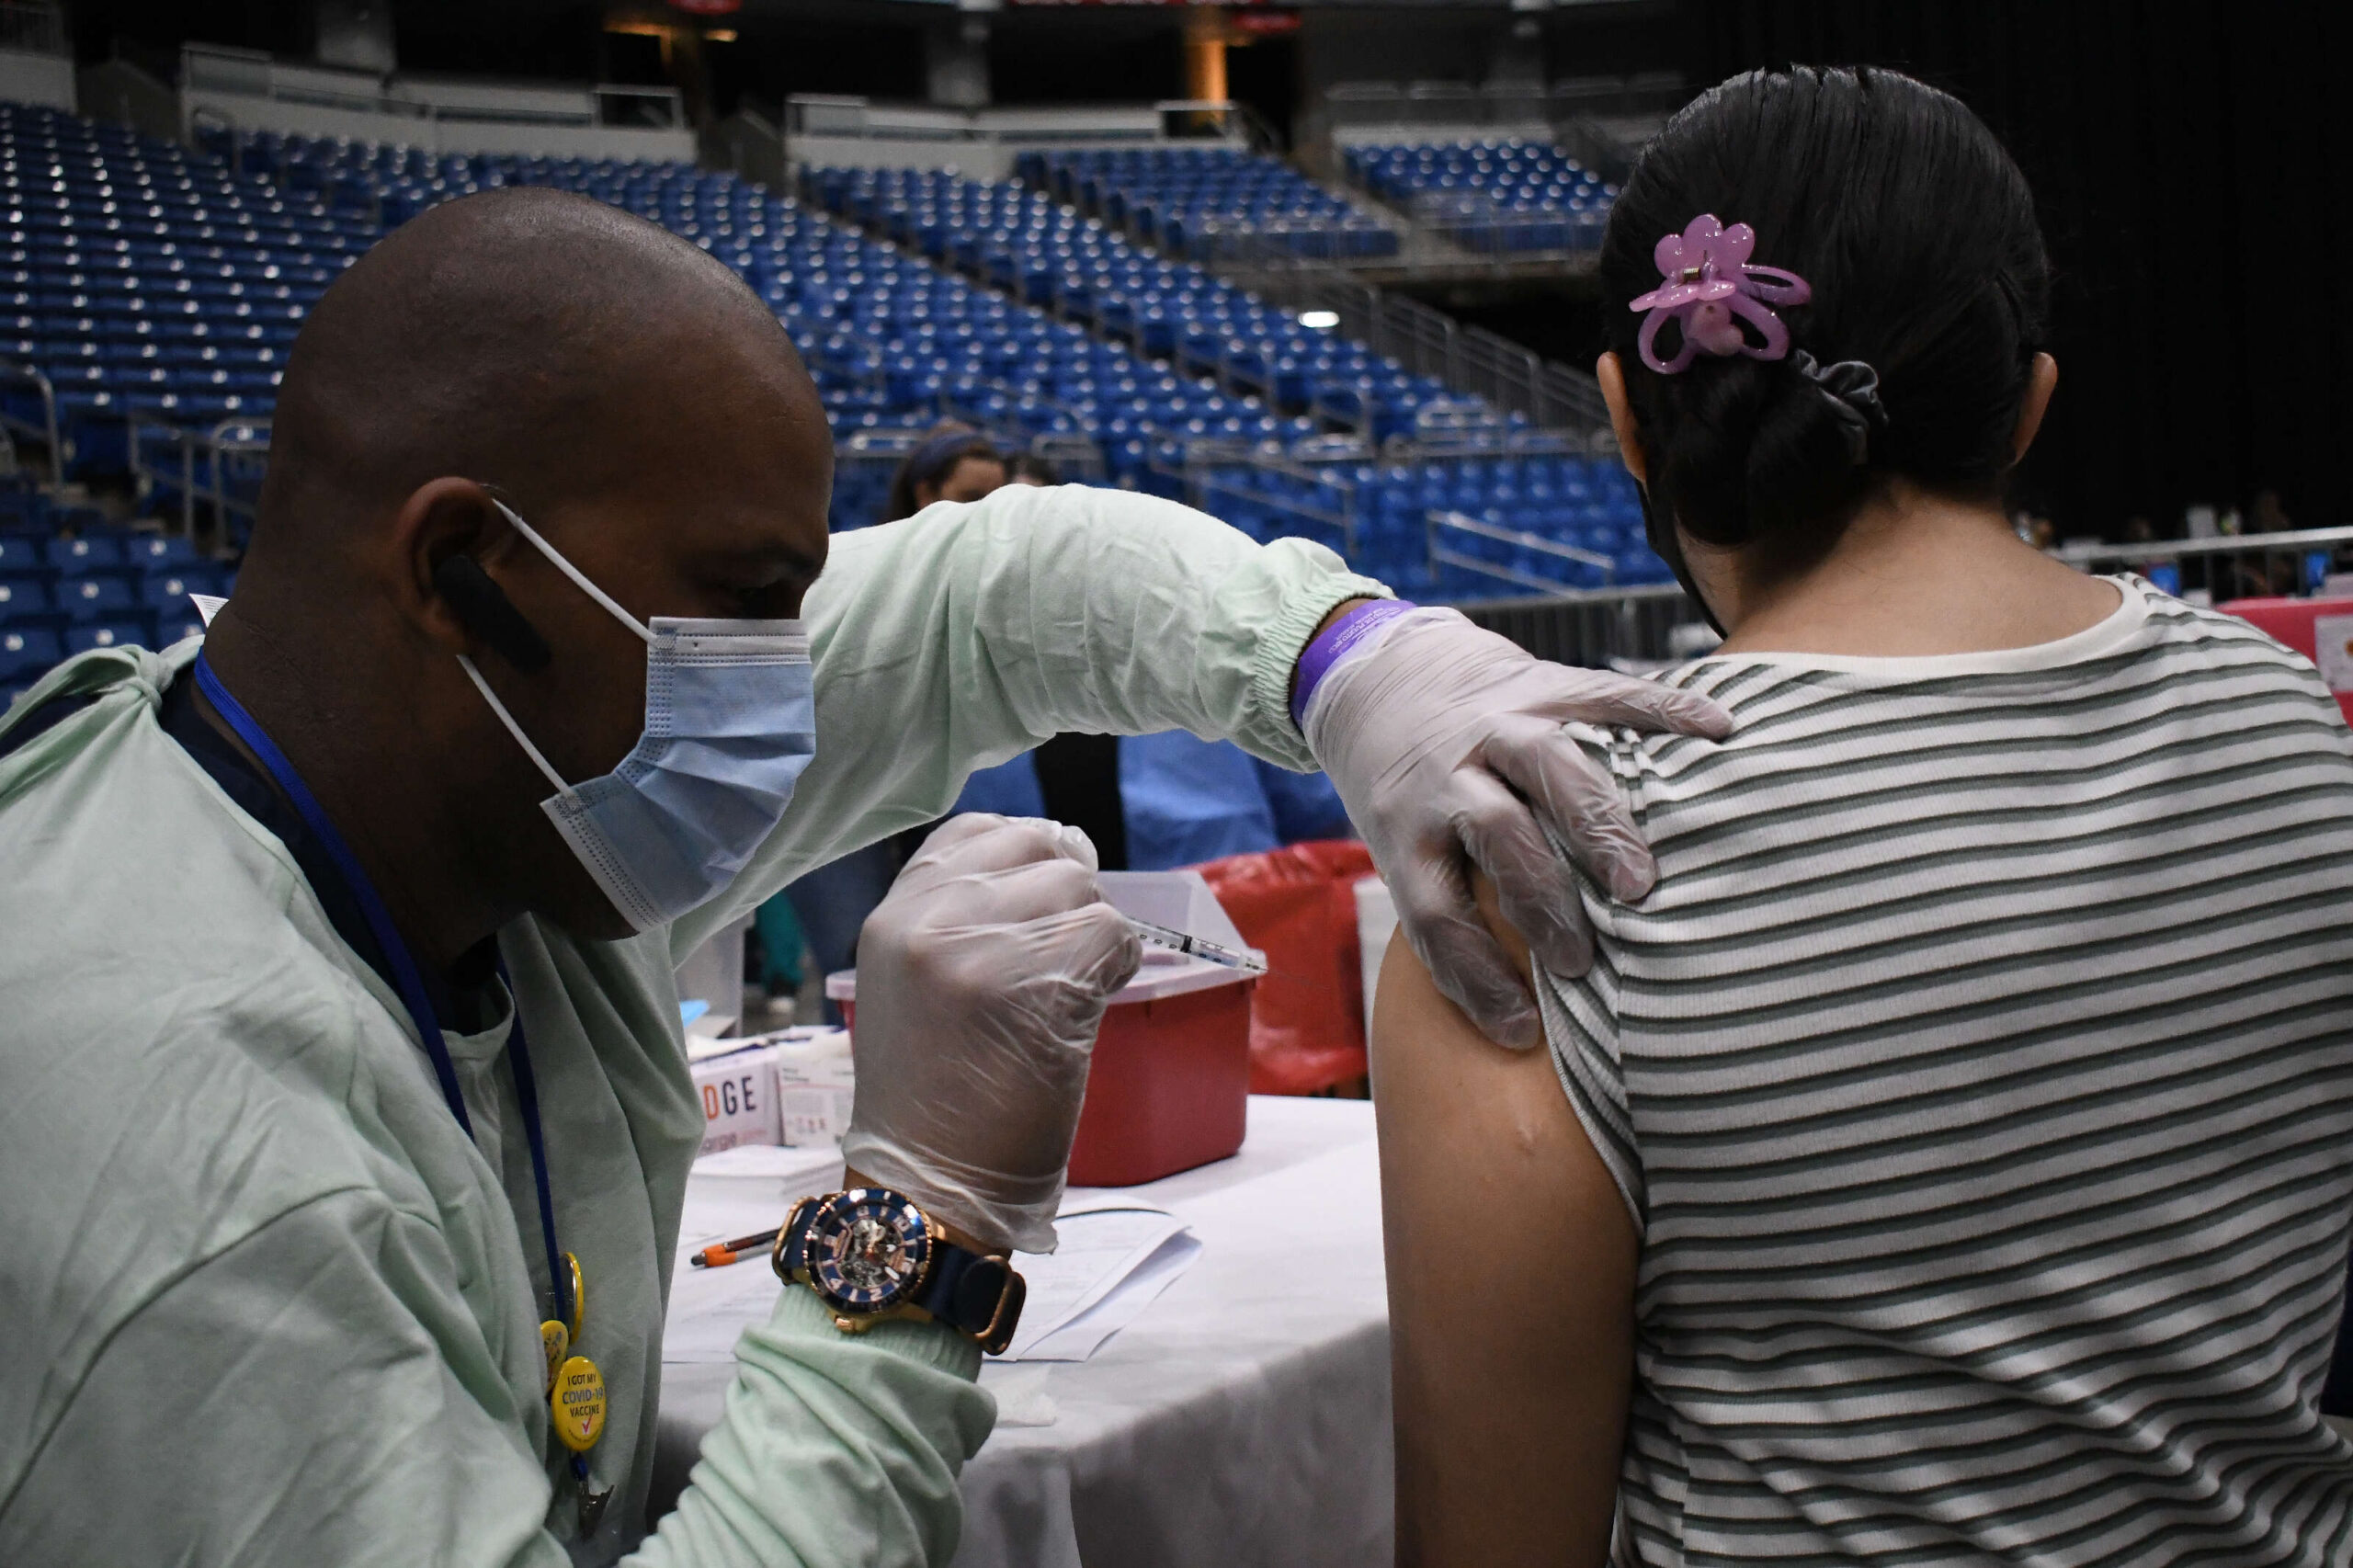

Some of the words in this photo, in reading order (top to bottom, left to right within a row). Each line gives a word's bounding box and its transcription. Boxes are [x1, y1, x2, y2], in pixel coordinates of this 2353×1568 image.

[567, 1376, 570, 1386] I
[572, 1373, 585, 1385] GOT
[587, 1372, 596, 1384] MY
[563, 1387, 603, 1404] COVID-19
[570, 1403, 599, 1416] VACCINE
